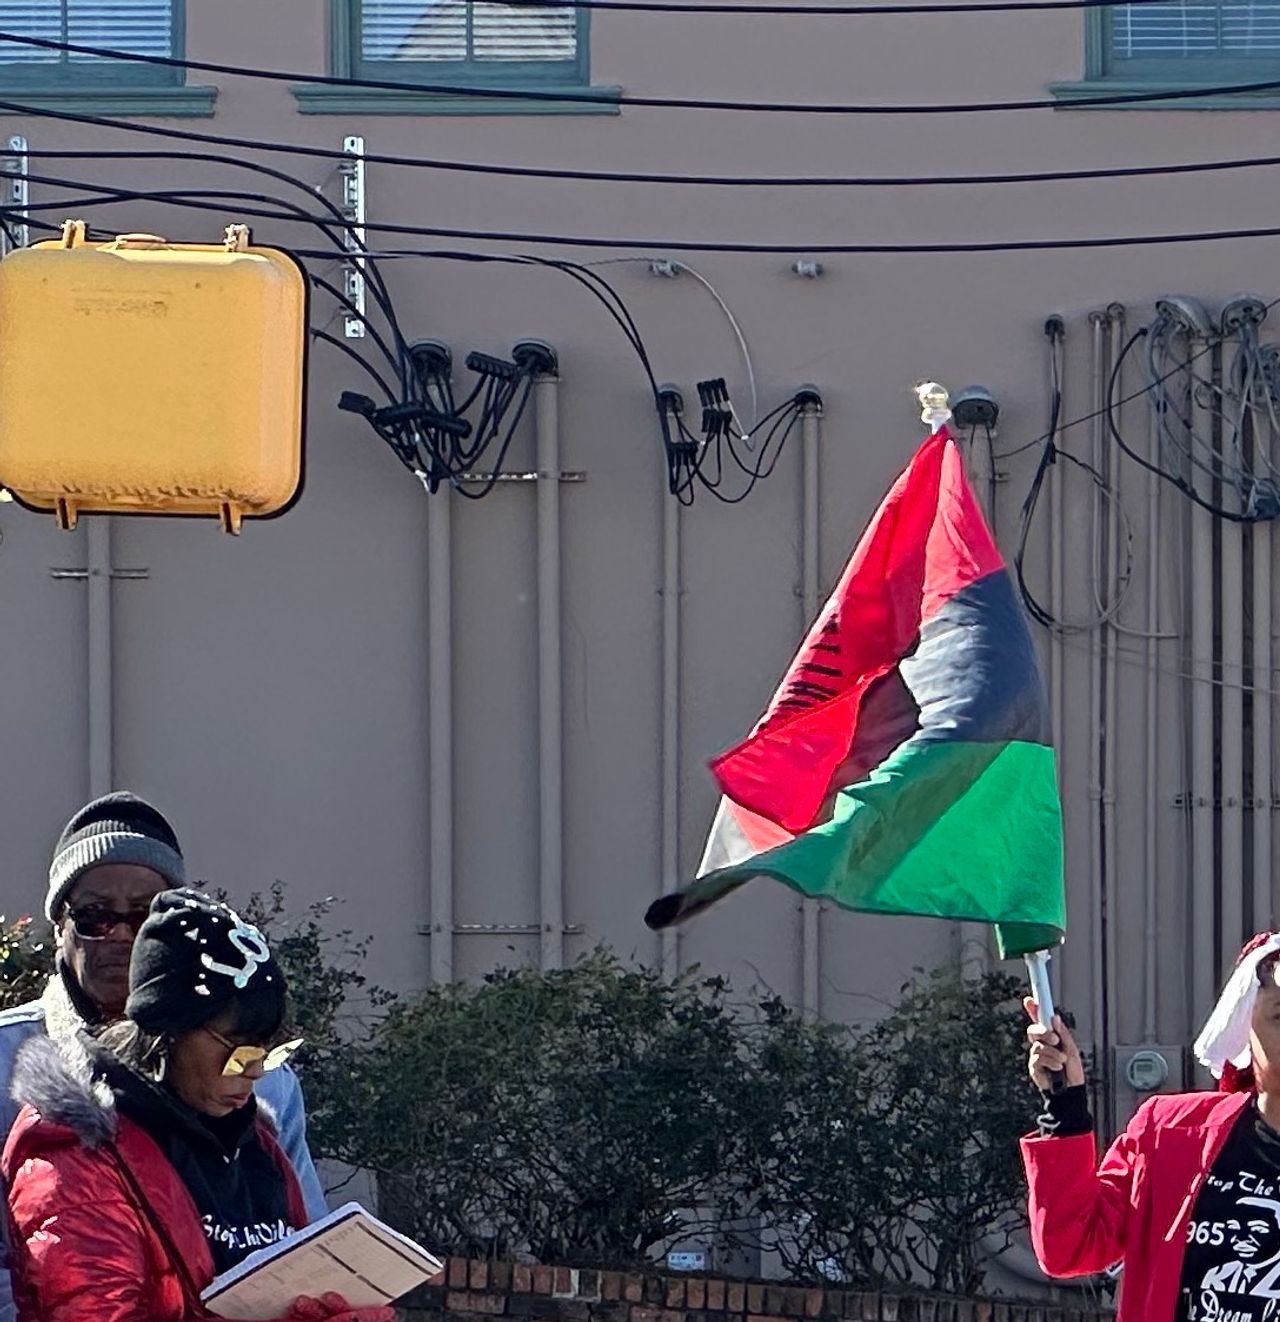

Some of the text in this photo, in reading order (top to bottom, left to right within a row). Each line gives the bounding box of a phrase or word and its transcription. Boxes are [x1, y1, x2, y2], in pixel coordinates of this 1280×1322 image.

[1206, 1174, 1234, 1192] top
[1238, 1171, 1274, 1196] The
[1186, 1220, 1225, 1246] 965
